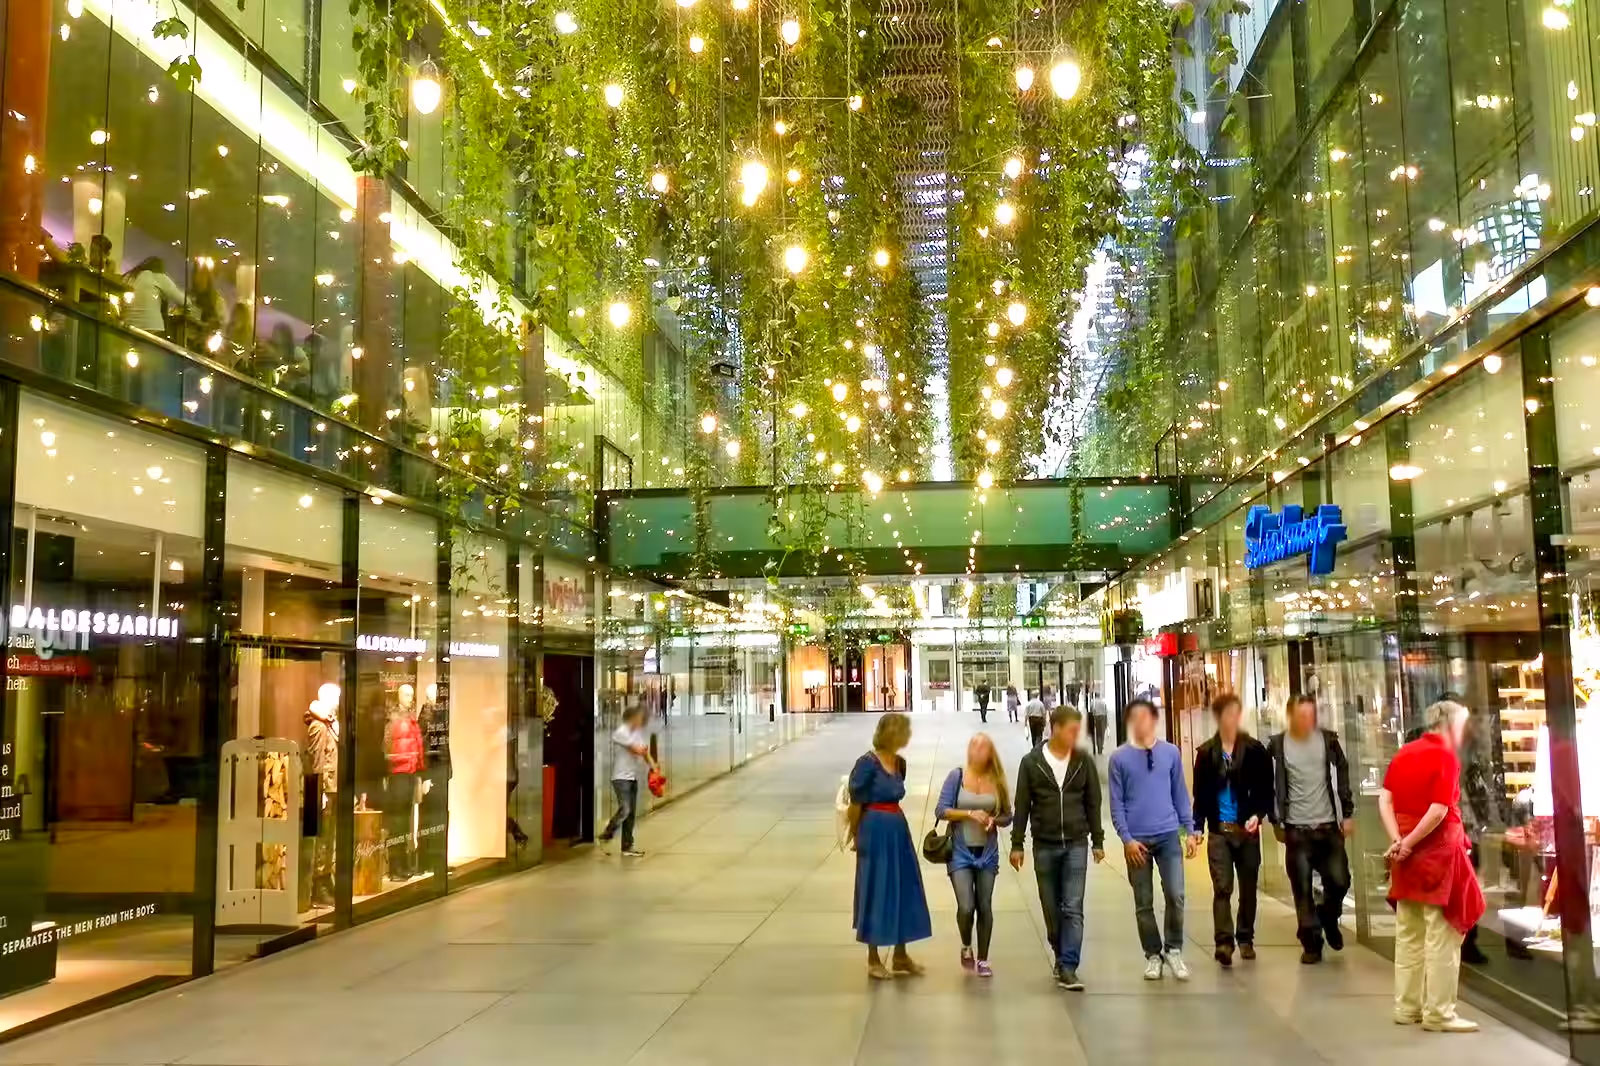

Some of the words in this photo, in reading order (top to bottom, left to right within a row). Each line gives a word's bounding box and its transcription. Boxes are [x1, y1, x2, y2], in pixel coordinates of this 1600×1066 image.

[2, 930, 53, 955] SEPARATES
[56, 925, 72, 940] THE
[74, 921, 93, 935] MEN
[95, 913, 118, 929] FROM
[120, 908, 134, 922] THE
[136, 903, 155, 918] BOYS
